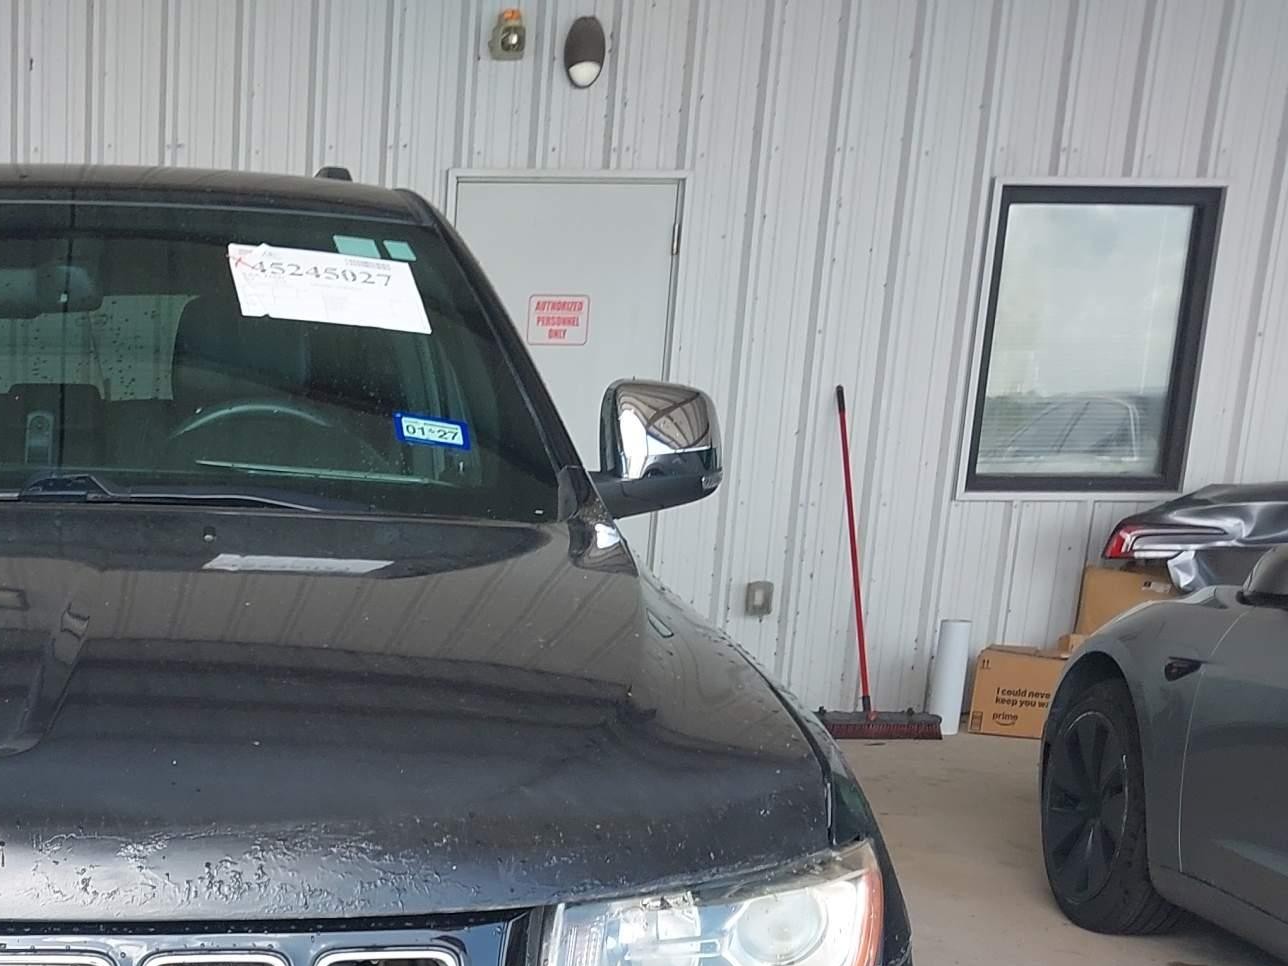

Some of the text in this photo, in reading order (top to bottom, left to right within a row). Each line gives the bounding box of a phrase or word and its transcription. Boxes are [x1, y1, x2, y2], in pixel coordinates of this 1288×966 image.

[535, 301, 584, 312] AUTHORIZED
[536, 316, 580, 327] PERSONNEL
[548, 328, 567, 339] ONLY
[1001, 687, 1027, 697] could
[995, 696, 1018, 707] keep
[1019, 698, 1036, 708] you
[992, 711, 1018, 721] prime
